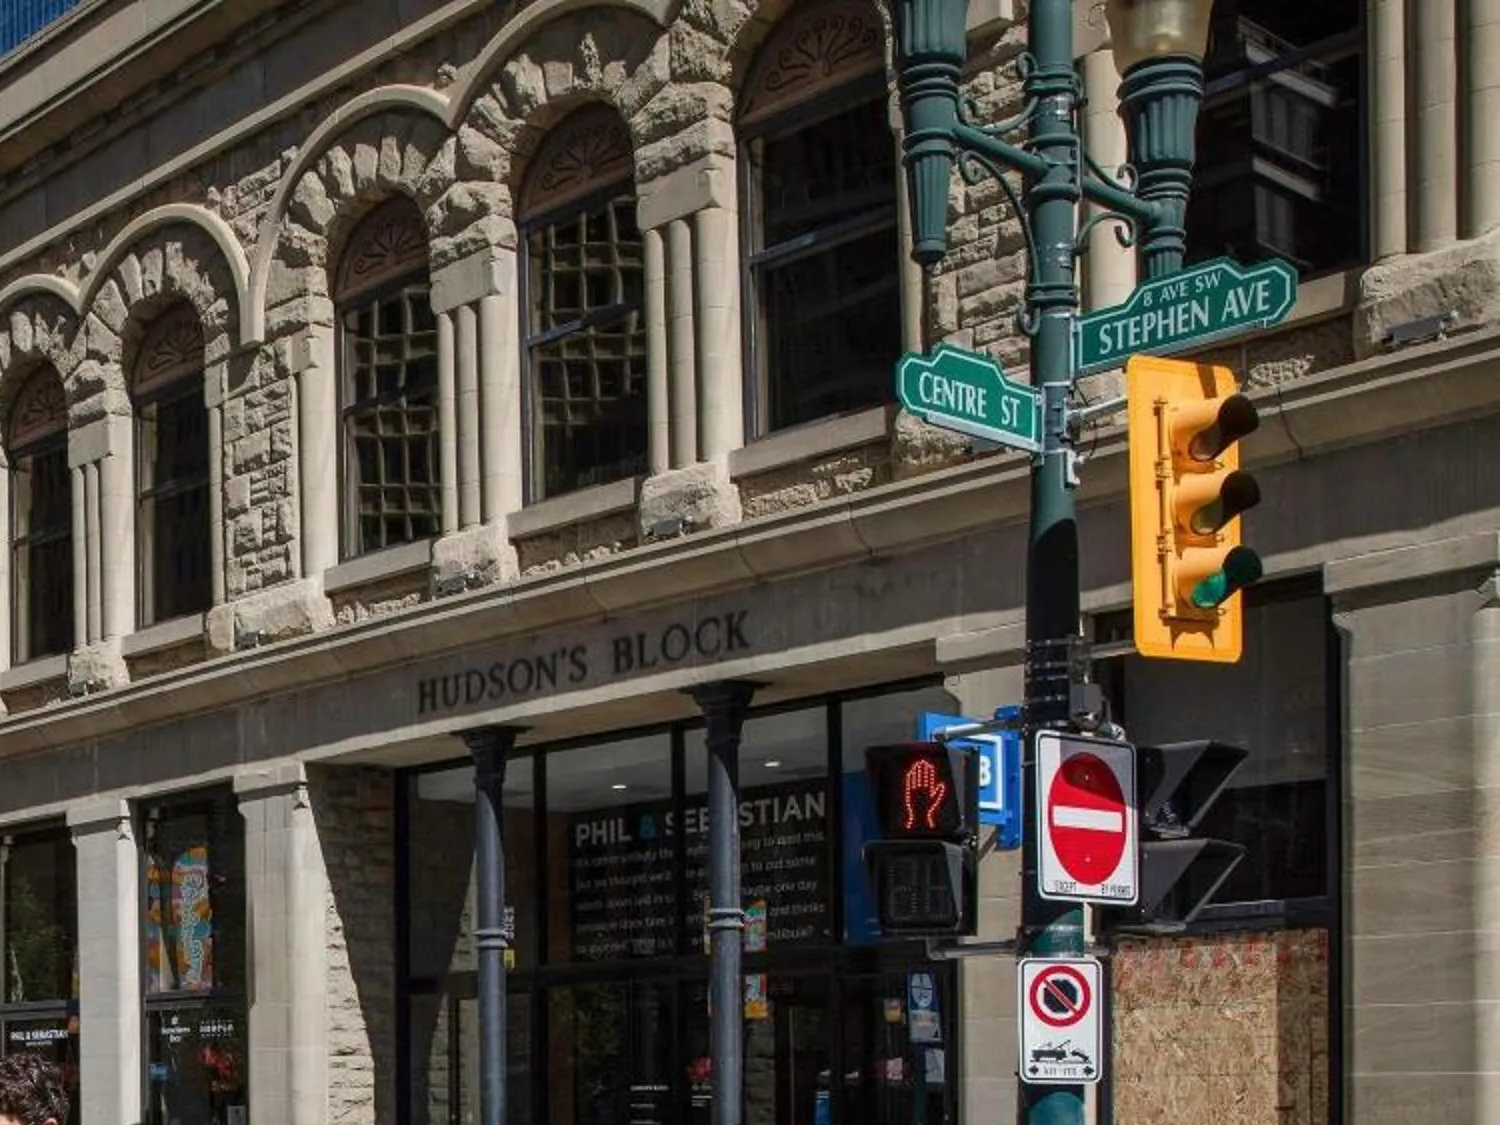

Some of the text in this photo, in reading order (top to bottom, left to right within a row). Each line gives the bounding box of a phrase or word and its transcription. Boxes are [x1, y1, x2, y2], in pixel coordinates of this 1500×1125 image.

[1143, 270, 1222, 307] 8 AVE SW
[1099, 279, 1271, 356] STEPHEN AVE
[920, 371, 1020, 427] CENTRE ST
[418, 610, 749, 714] HUDSON'S BLOCK
[576, 791, 825, 847] PHIL & SEBSTIAN
